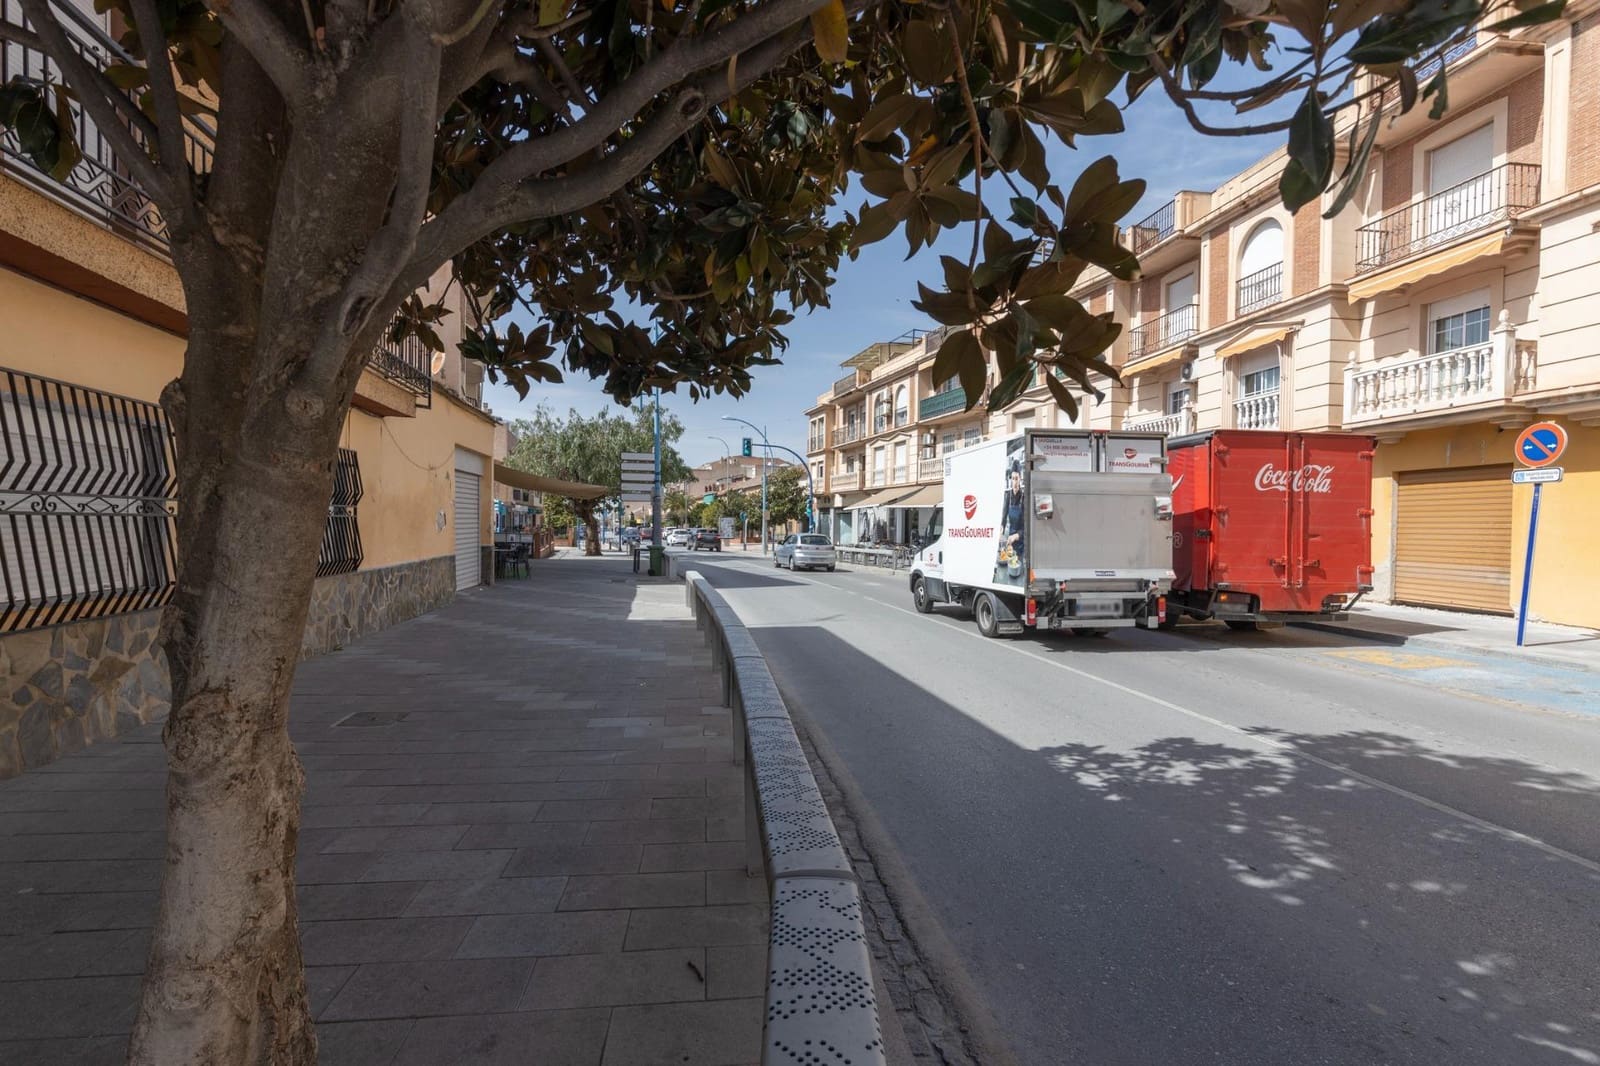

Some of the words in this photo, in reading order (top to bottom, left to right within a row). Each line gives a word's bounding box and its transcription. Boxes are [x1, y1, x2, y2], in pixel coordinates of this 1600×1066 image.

[1108, 461, 1153, 469] TRANSGOURMET
[1254, 463, 1335, 493] Coca-Cola
[948, 526, 994, 538] TRANSGOURMET
